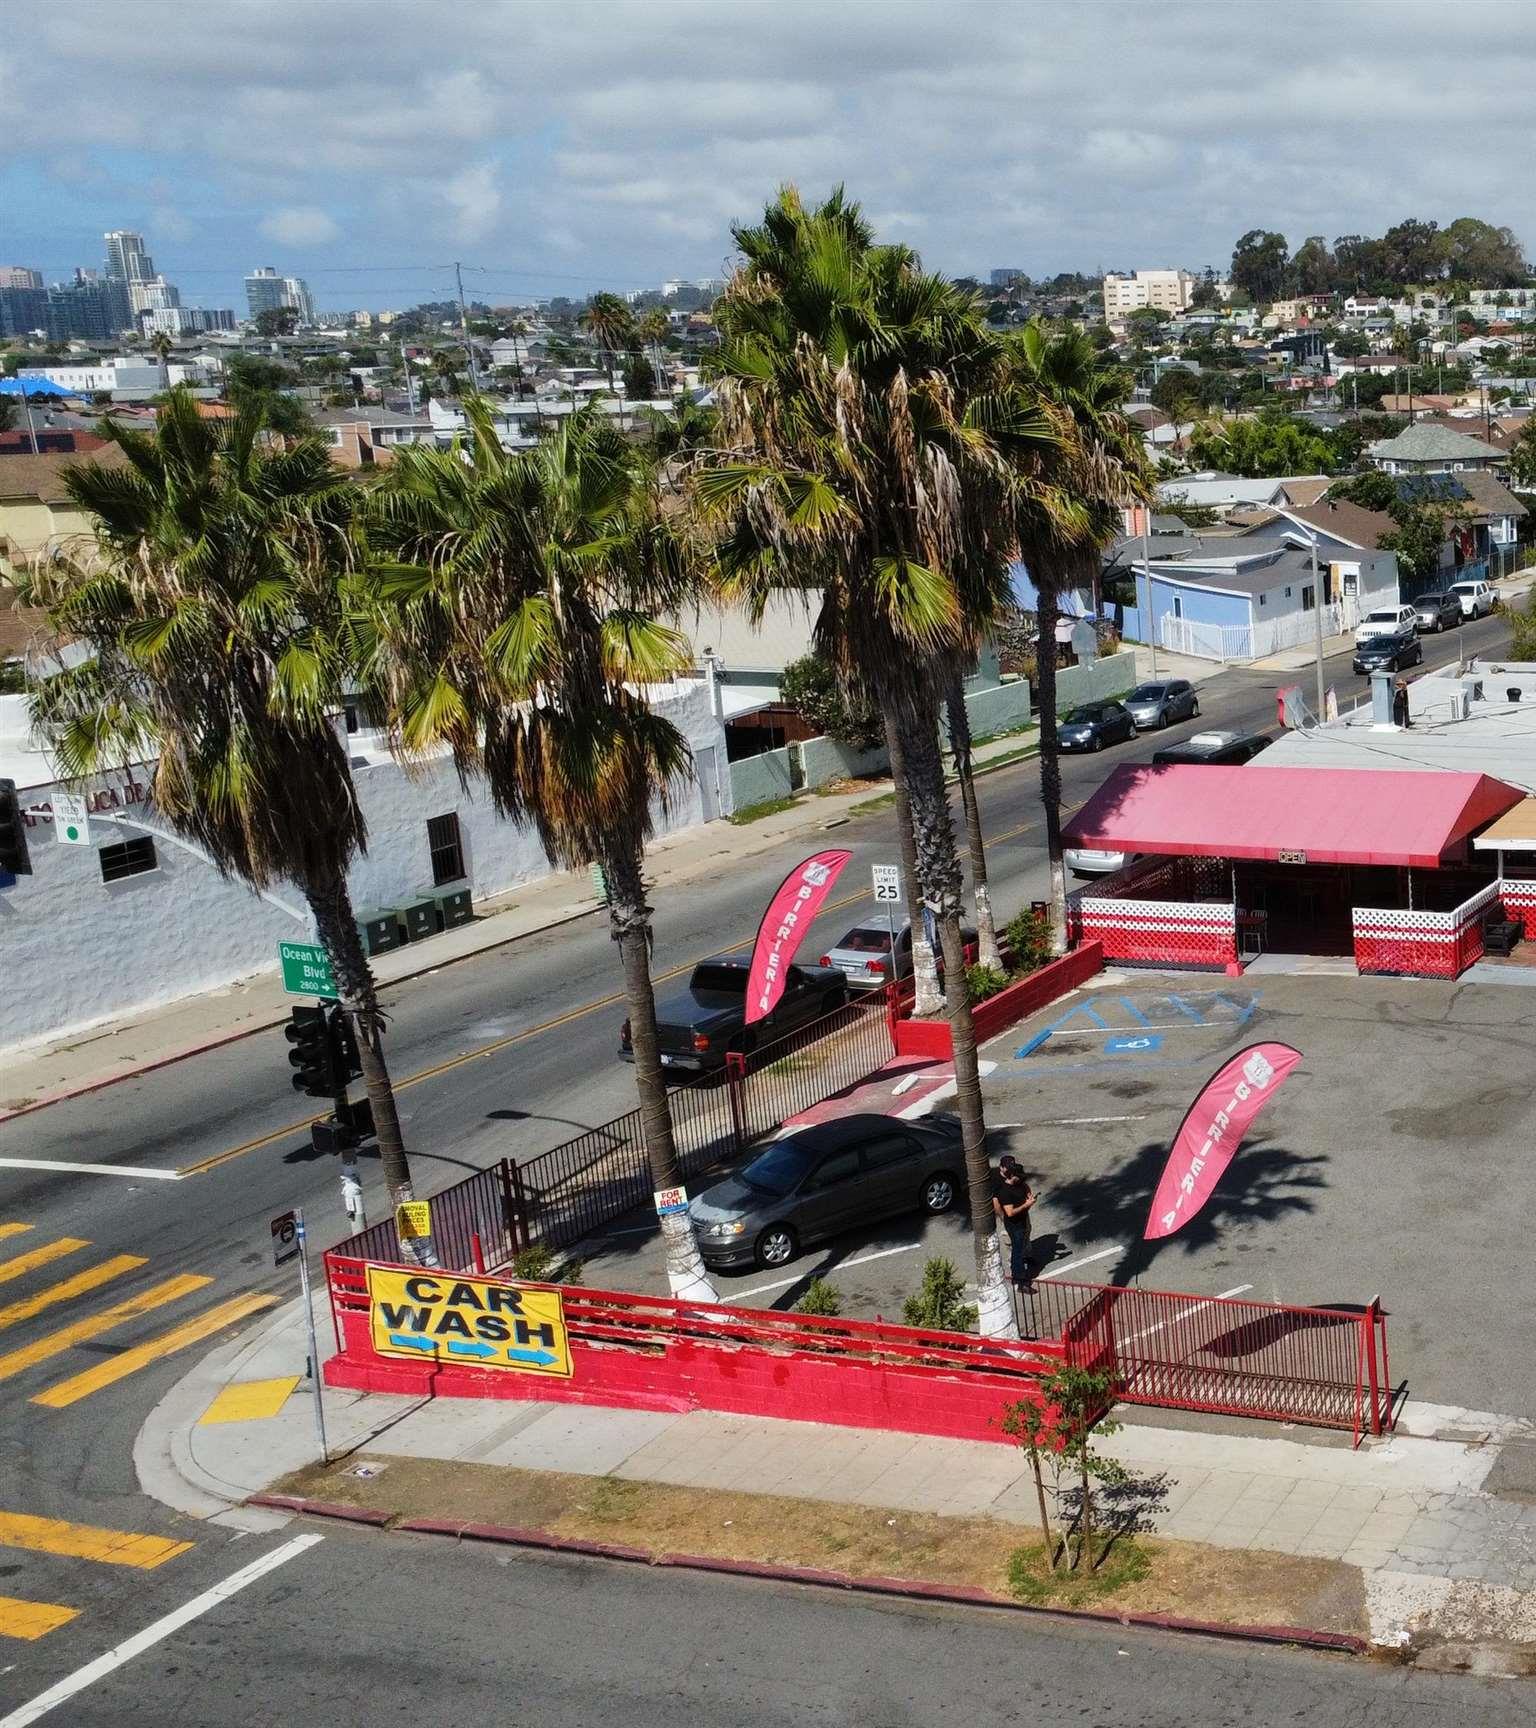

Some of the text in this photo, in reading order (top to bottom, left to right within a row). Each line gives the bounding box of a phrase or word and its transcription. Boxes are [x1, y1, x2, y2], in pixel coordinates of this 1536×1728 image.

[1279, 851, 1306, 864] OPEN
[877, 885, 898, 899] 25
[282, 946, 313, 962] Ocean
[759, 885, 812, 1012] BIRRIERIA
[303, 965, 326, 979] Blvd
[1161, 1081, 1252, 1229] BIRRIERIA
[660, 1189, 681, 1200] FOR
[660, 1195, 684, 1208] RENT
[405, 1277, 526, 1316] CAR
[380, 1302, 556, 1348] WASH
